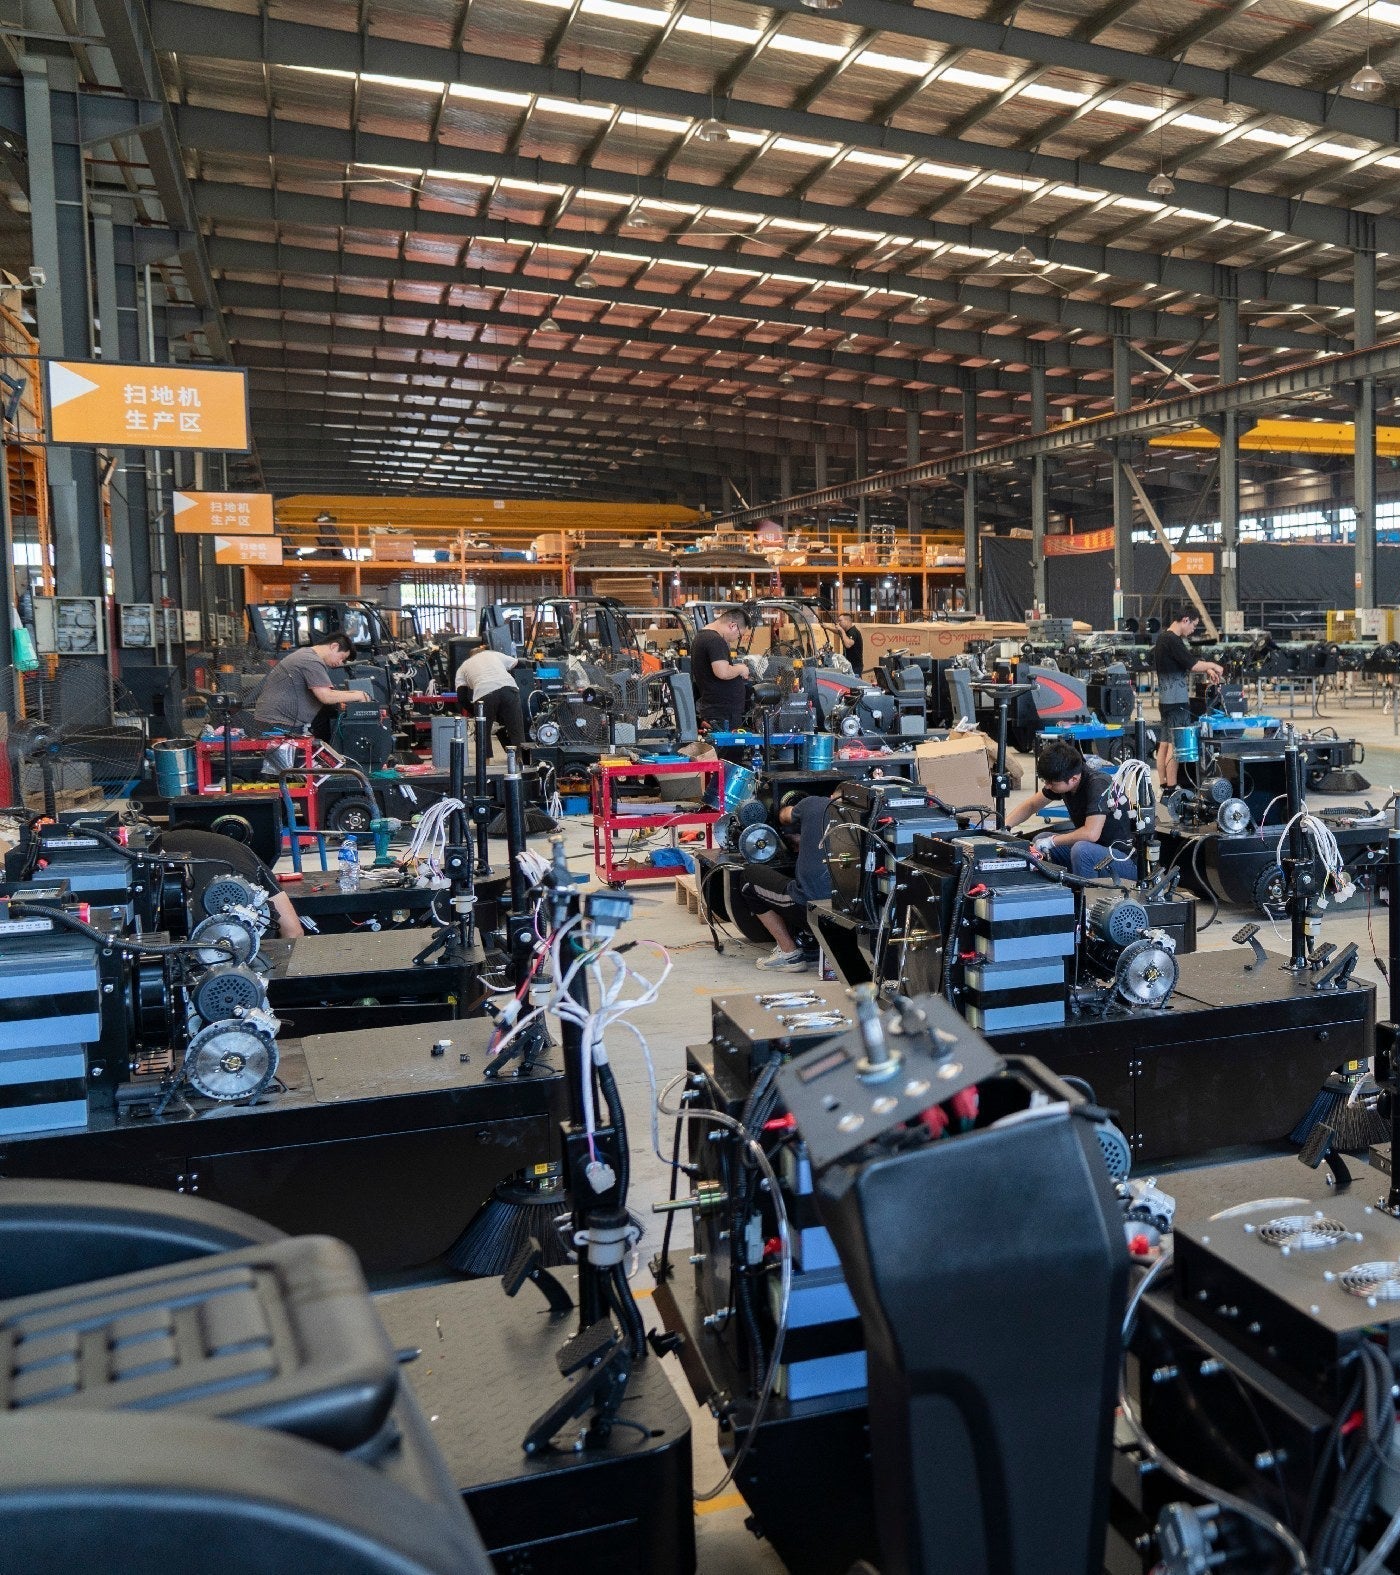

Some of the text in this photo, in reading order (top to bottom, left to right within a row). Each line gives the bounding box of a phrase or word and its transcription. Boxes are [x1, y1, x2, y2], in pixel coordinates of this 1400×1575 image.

[123, 383, 202, 407] 扫地机
[124, 409, 202, 432] 生产区
[210, 501, 250, 513] 扫地机
[210, 515, 250, 526] 生产区
[886, 635, 921, 643] YANGZI
